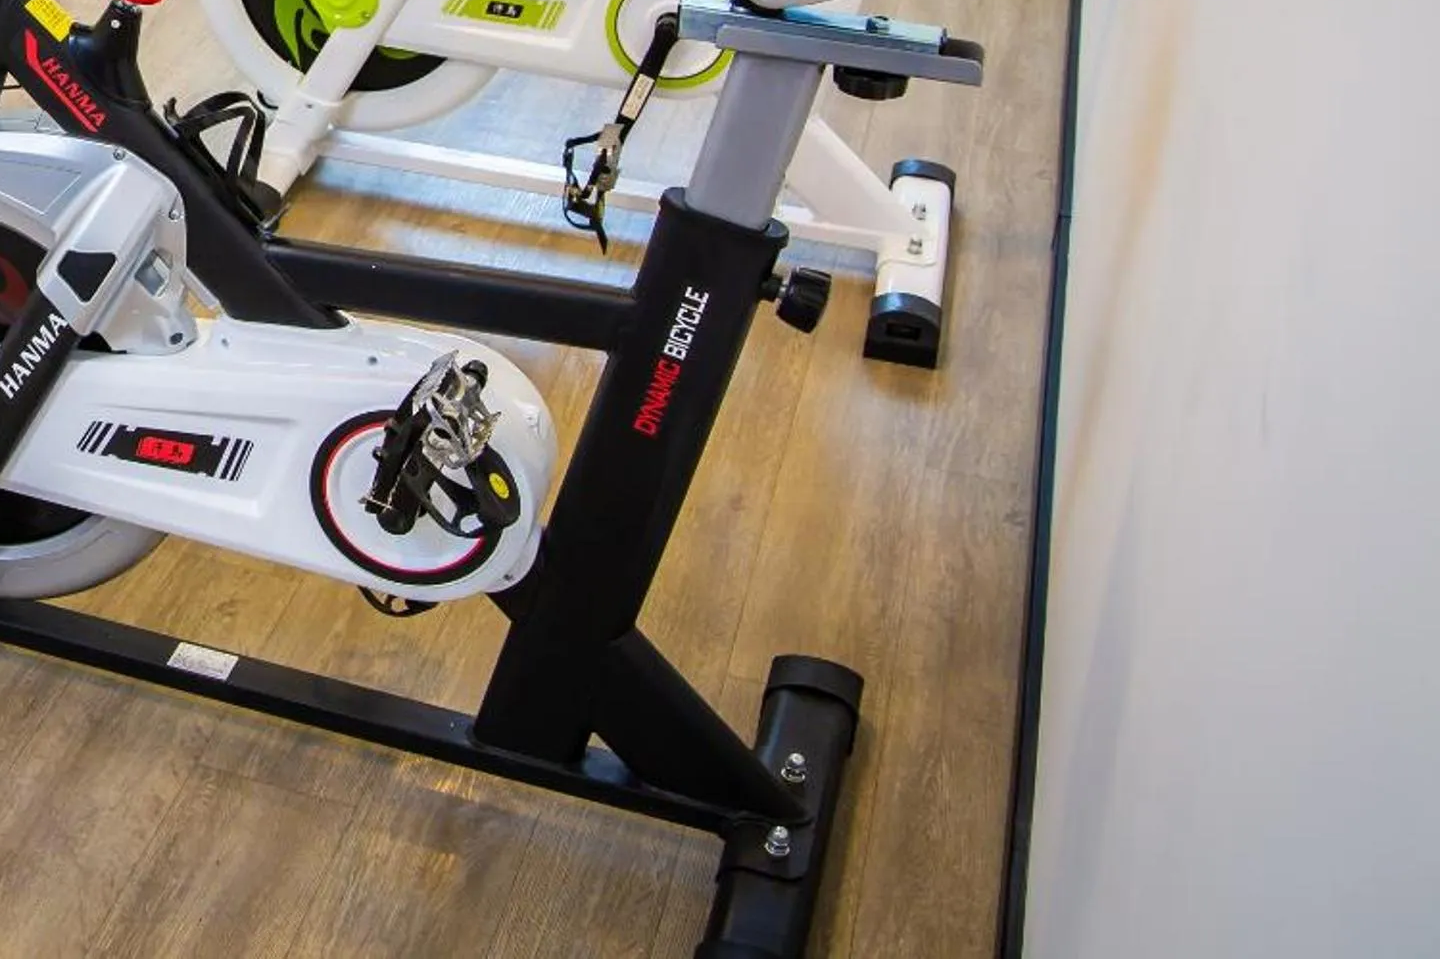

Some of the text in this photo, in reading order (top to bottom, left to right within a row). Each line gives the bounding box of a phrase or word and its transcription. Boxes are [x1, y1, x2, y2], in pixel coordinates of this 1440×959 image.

[42, 56, 106, 128] HANMA
[632, 286, 710, 436] DYNAMIC BICYCLE
